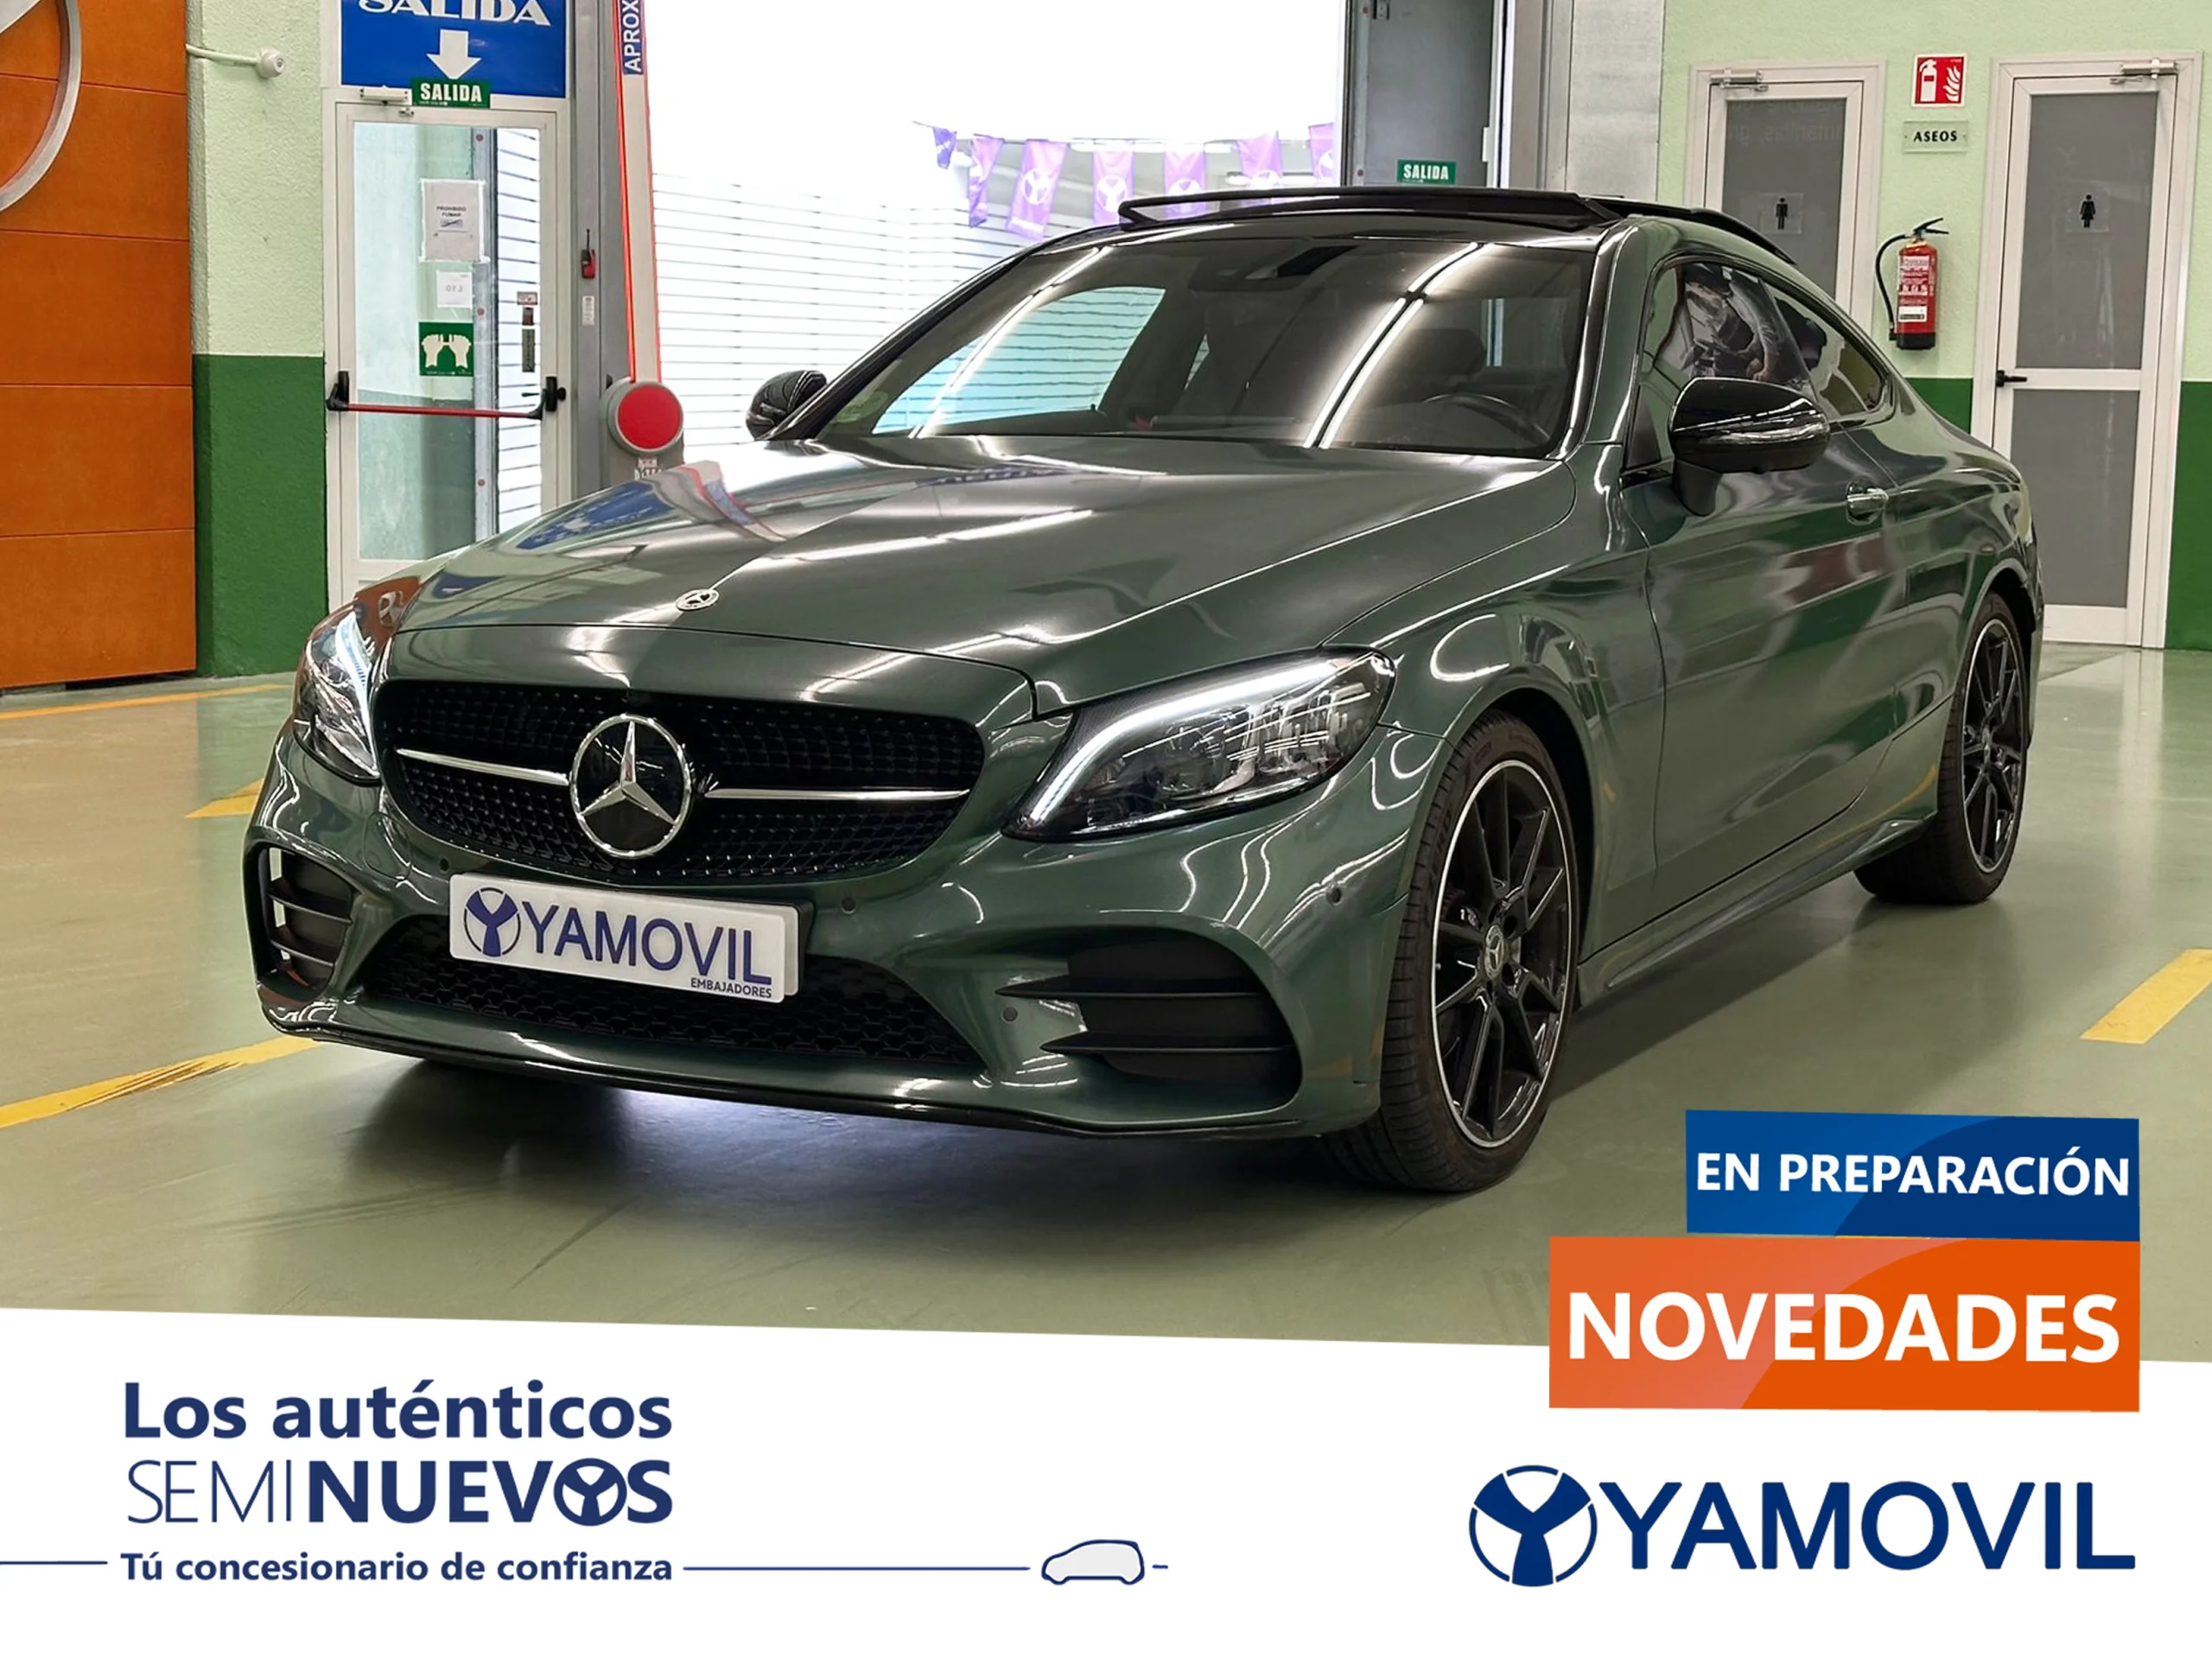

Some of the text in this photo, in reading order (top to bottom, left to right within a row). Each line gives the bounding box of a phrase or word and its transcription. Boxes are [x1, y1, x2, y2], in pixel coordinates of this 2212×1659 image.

[420, 83, 482, 102] SALIDA
[1913, 130, 1958, 142] ASEOS
[1403, 163, 1449, 181] SALIDA
[522, 901, 772, 986] YAMOVIL
[690, 977, 772, 999] EMBAJADORES
